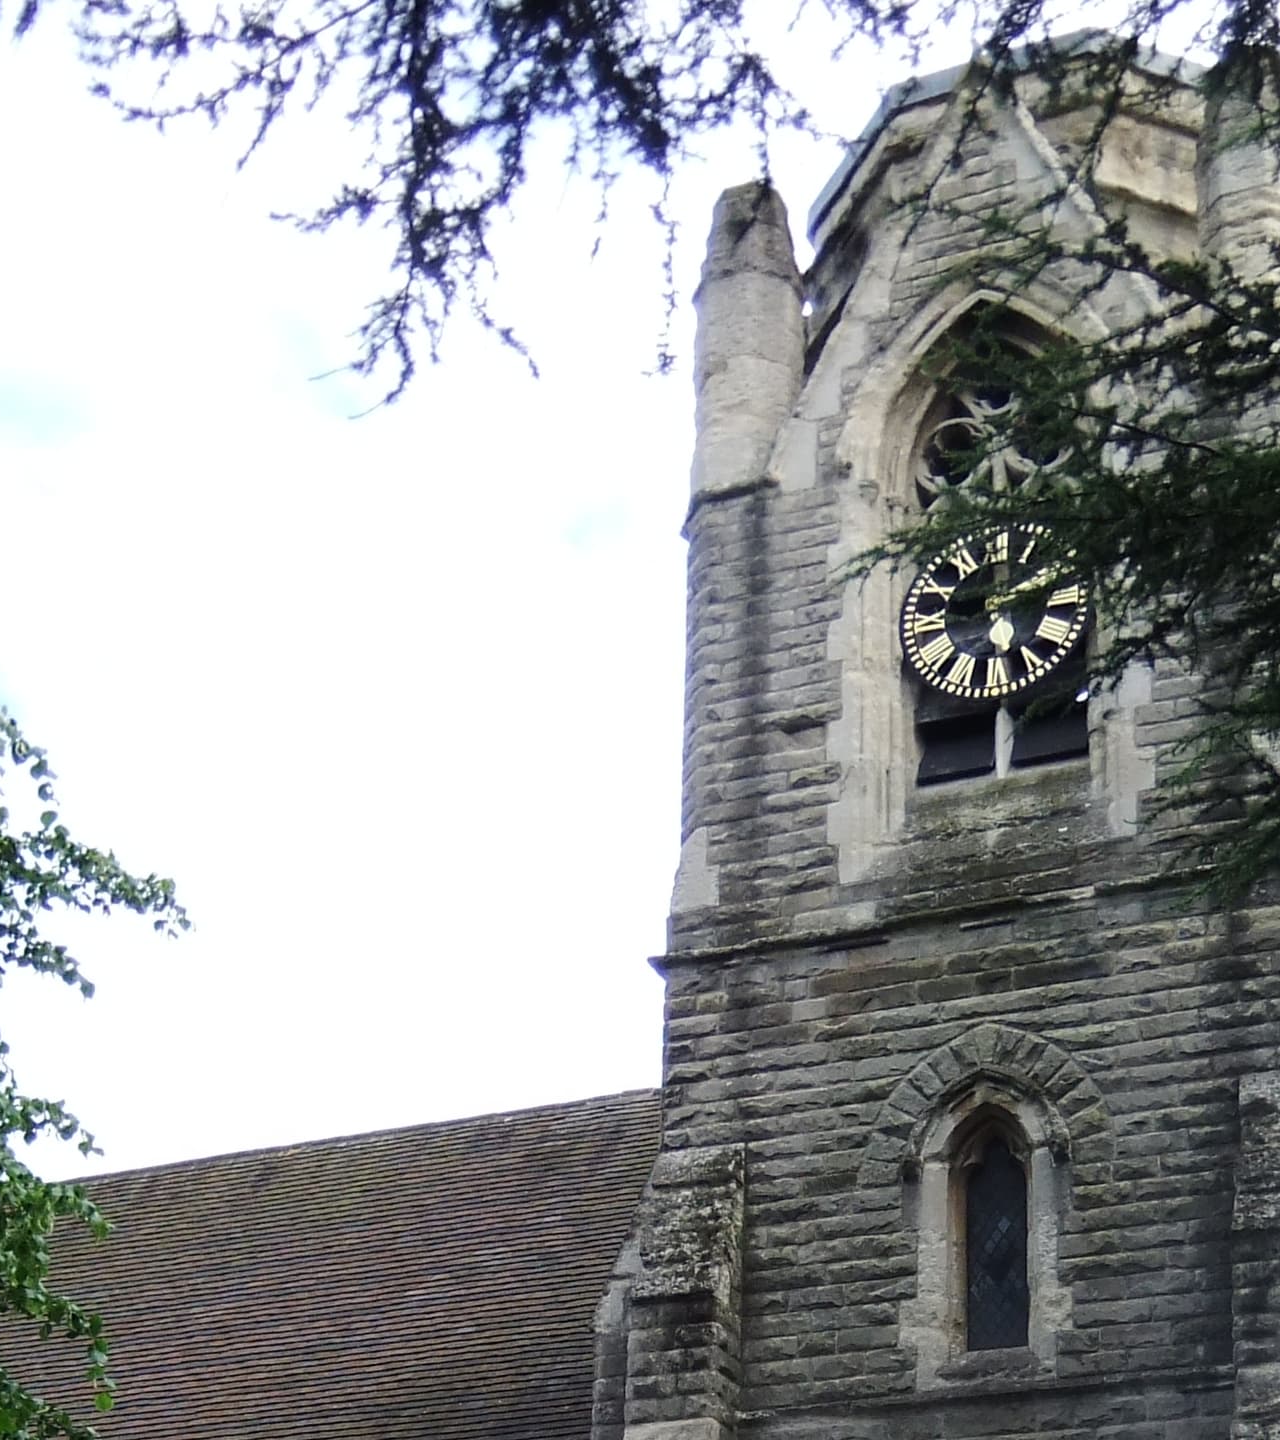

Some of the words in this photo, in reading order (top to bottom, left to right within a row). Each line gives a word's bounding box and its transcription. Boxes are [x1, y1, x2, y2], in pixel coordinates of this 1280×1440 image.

[949, 549, 979, 581] XI
[922, 577, 956, 602] X
[1047, 584, 1079, 607] III
[914, 608, 946, 634] IX
[1035, 614, 1071, 645] IIII
[919, 632, 956, 673] VIII
[1020, 645, 1044, 672] V
[945, 652, 976, 687] VII
[986, 656, 1009, 688] VI
